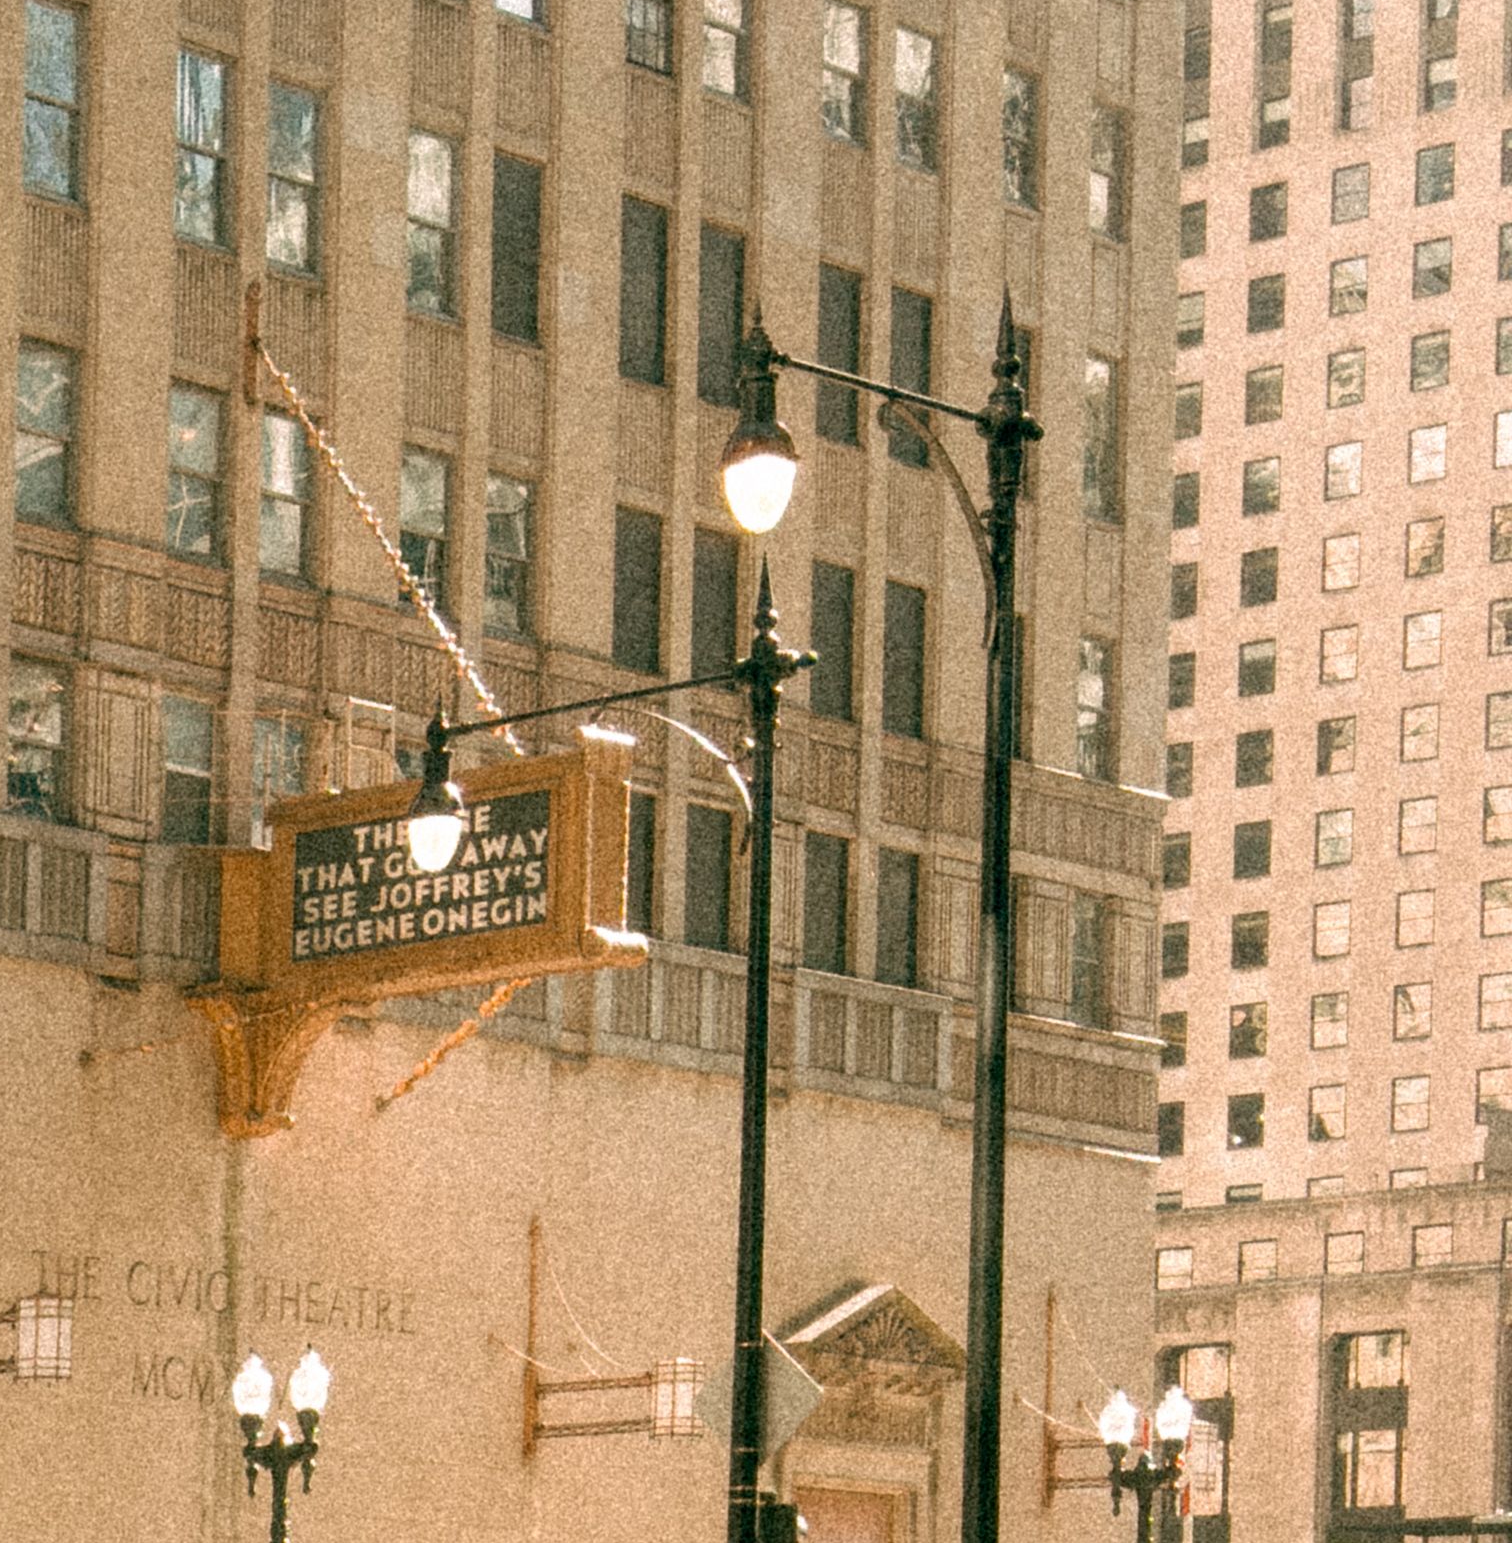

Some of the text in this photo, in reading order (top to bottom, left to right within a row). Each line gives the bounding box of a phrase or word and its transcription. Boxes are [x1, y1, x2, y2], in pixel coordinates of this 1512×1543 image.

[297, 857, 375, 893] THAT
[460, 828, 548, 868] AWAY
[303, 861, 542, 924] SEE JOFFREY'S
[295, 892, 547, 956] EUGENE ONEGIN
[31, 1248, 417, 1336] THE CIVIC THEATRE
